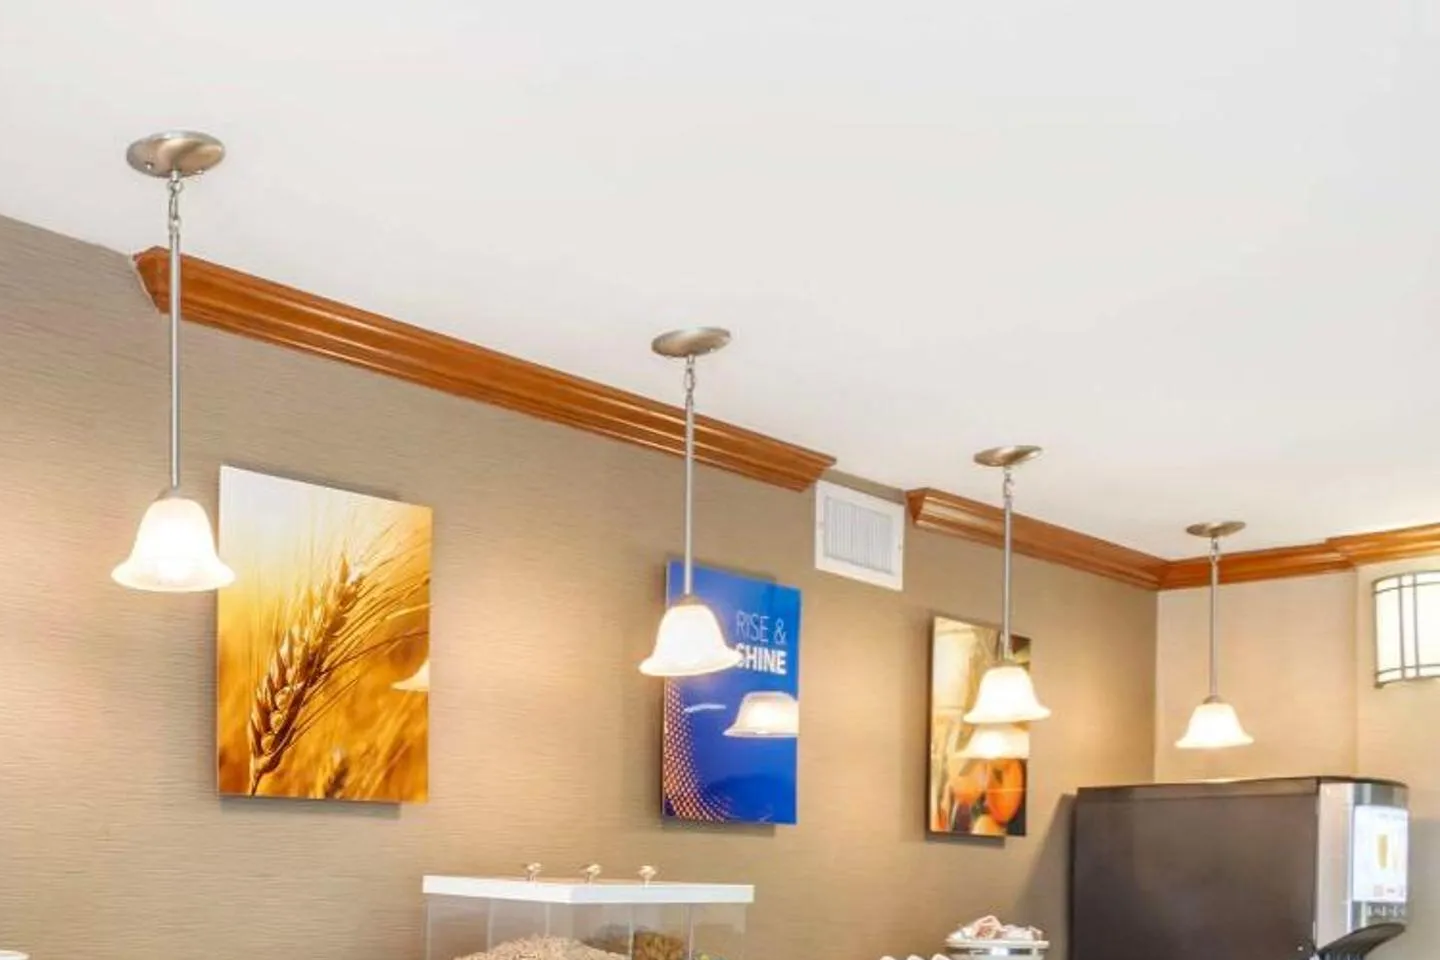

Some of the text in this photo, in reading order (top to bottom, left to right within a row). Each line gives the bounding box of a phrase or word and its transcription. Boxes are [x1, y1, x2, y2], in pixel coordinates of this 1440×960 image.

[736, 610, 787, 646] RISE &
[736, 642, 788, 675] SHINE
